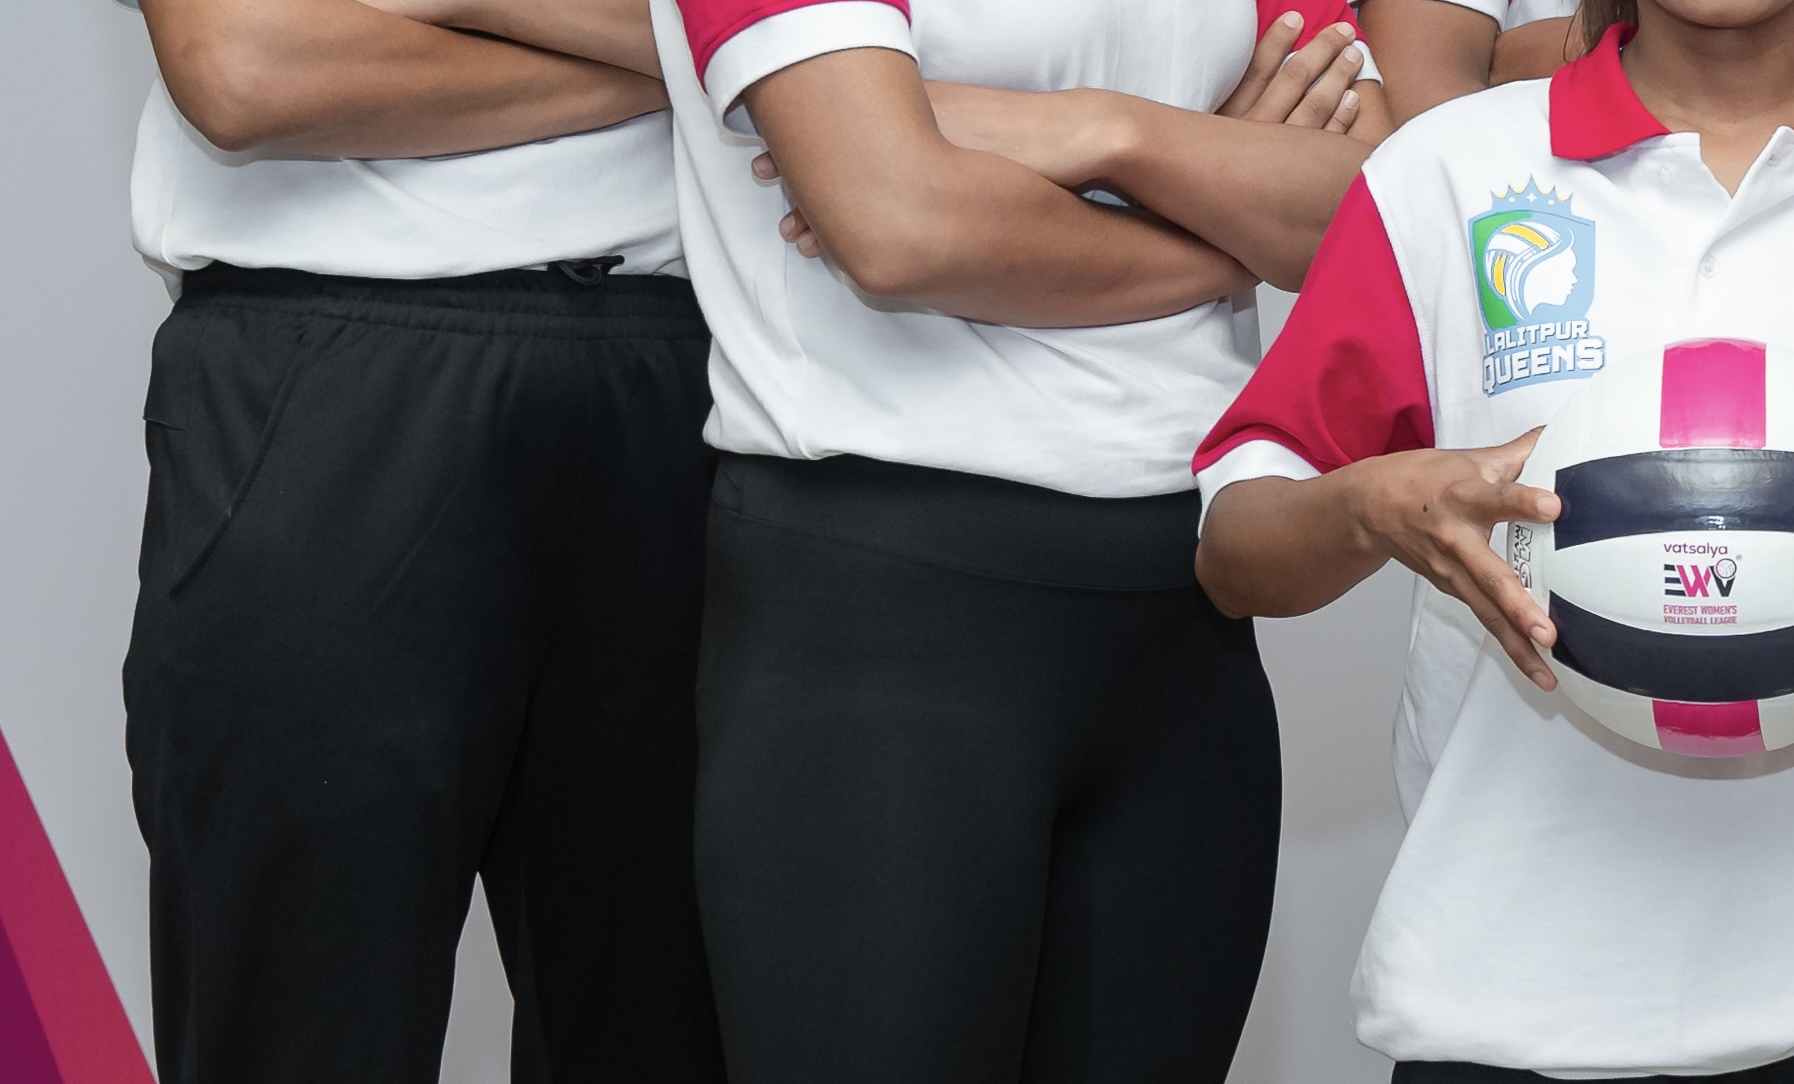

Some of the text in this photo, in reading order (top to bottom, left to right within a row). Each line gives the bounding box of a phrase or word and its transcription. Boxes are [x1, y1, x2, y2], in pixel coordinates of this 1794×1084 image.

[1485, 320, 1590, 356] LALITPUR
[1483, 338, 1606, 395] QUEENS
[1663, 541, 1729, 559] vatsalya
[1663, 603, 1738, 616] EVEREST WOMEN'S
[1663, 615, 1710, 626] VOLLEYBALL
